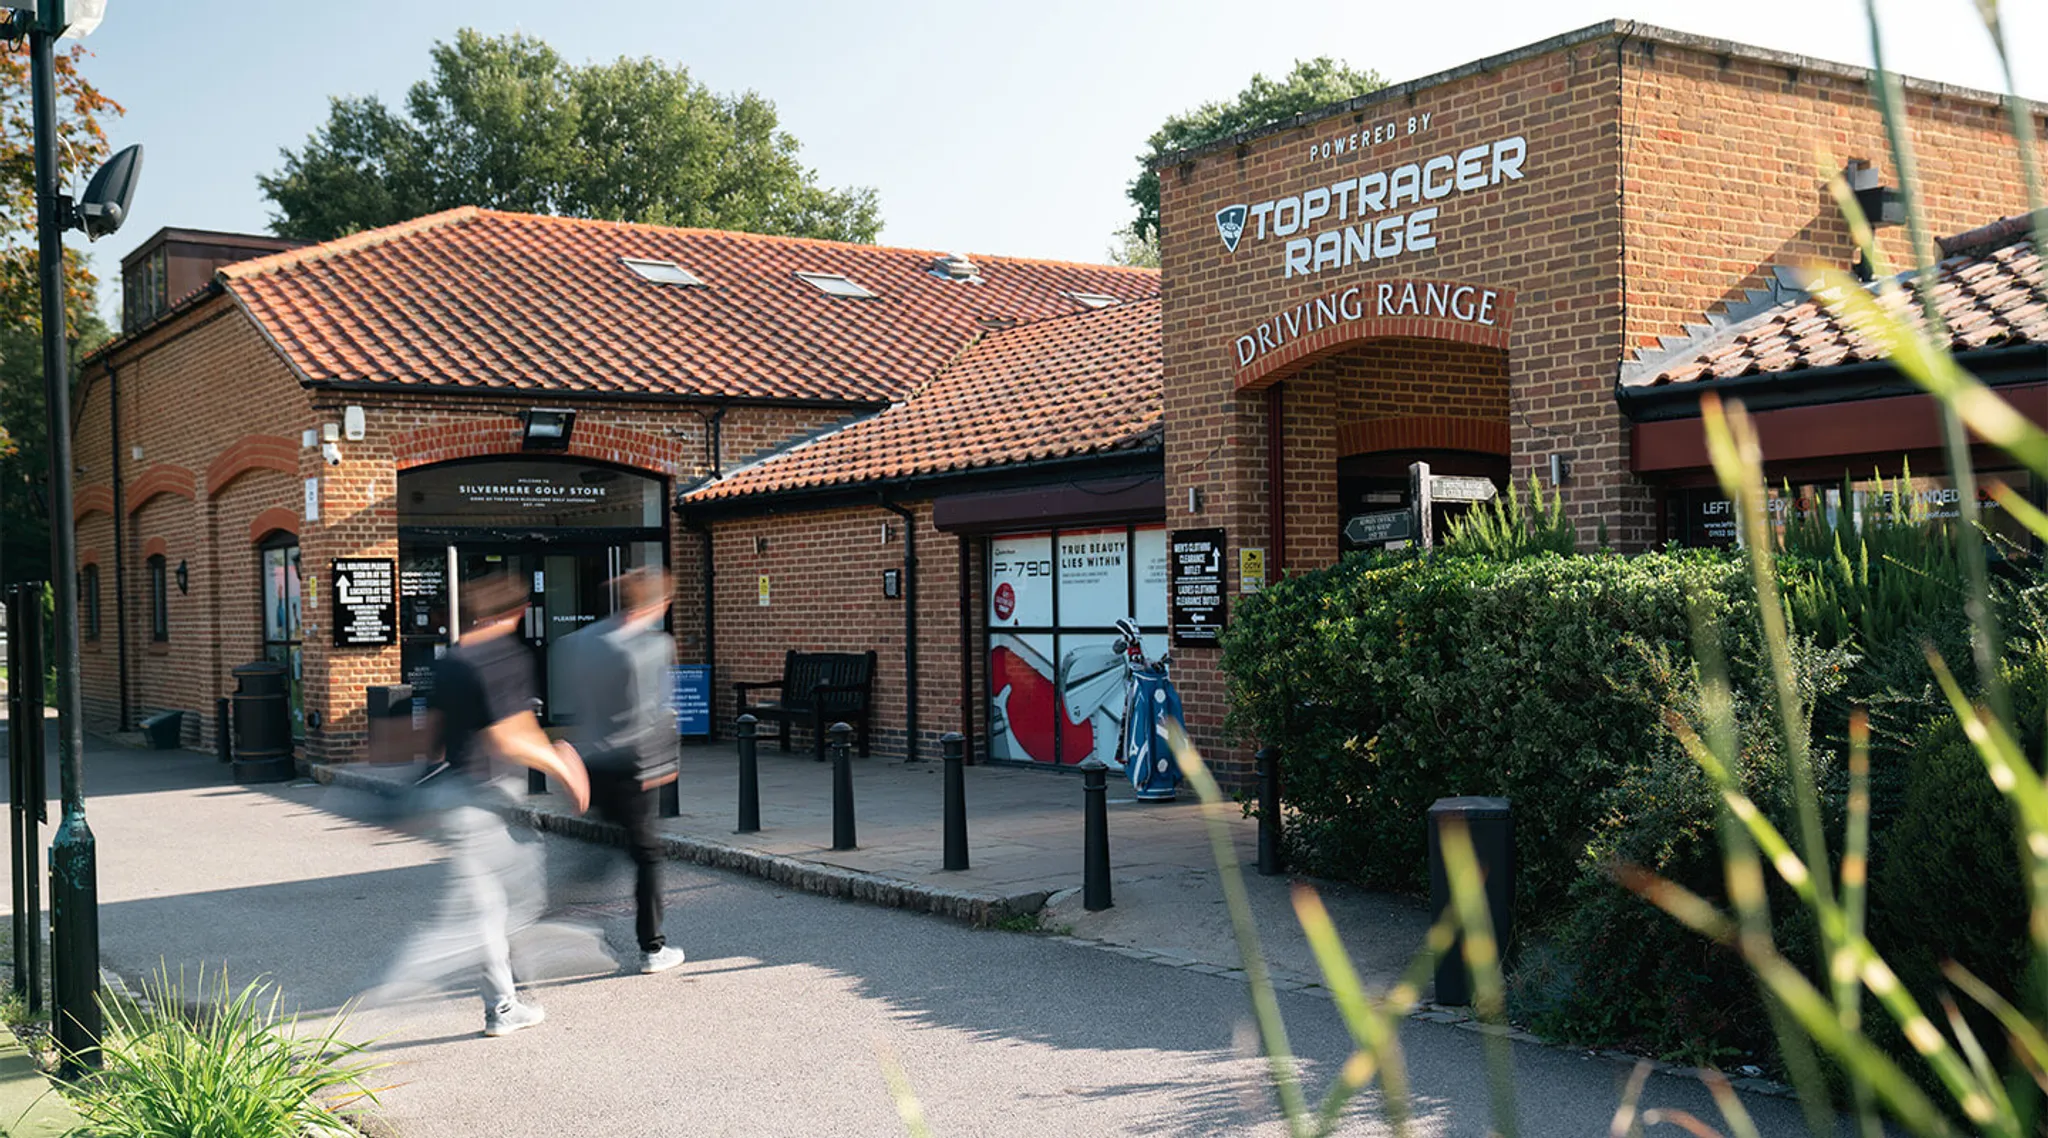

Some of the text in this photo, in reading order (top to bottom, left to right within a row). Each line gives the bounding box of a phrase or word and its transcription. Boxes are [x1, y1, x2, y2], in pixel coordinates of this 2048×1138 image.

[1310, 112, 1433, 161] POWERED BY
[1250, 136, 1527, 240] TOPTRACER
[1285, 207, 1438, 279] RANGE
[1235, 282, 1498, 367] DRIVING RANGE
[459, 485, 606, 496] SILVERMERE GOLF STORE
[1702, 500, 1731, 515] LEFT
[1062, 542, 1126, 556] TRUE BEAUTY
[1062, 556, 1121, 569] LIES WITHIN
[1244, 561, 1261, 570] CCTV
